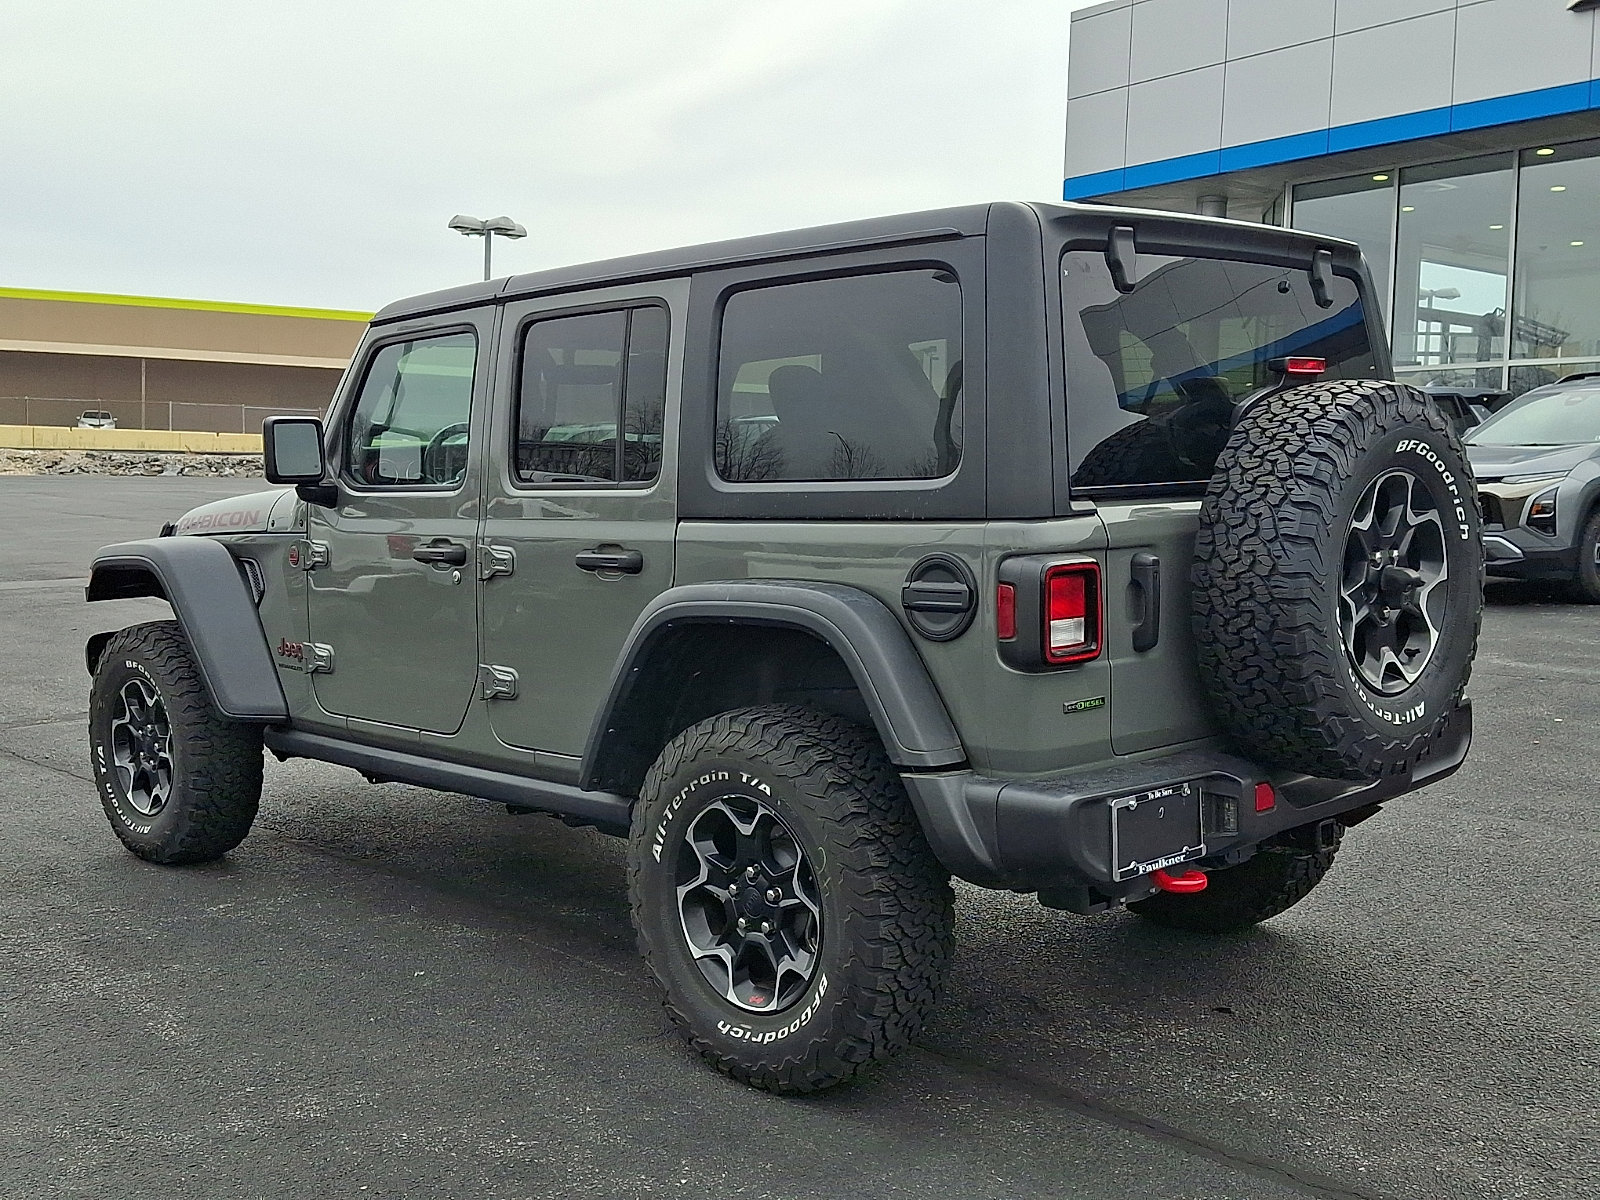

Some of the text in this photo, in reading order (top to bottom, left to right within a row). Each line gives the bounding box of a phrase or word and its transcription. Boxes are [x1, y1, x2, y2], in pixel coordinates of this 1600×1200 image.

[1395, 440, 1470, 540] BFGoodrich
[277, 637, 304, 663] Jeep
[106, 783, 152, 834] All-Terrain
[652, 770, 771, 864] All-Terrain T/A
[1147, 788, 1174, 801] To Be Sure
[1138, 854, 1186, 875] Faulkner
[717, 973, 828, 1045] BFGoodrich
